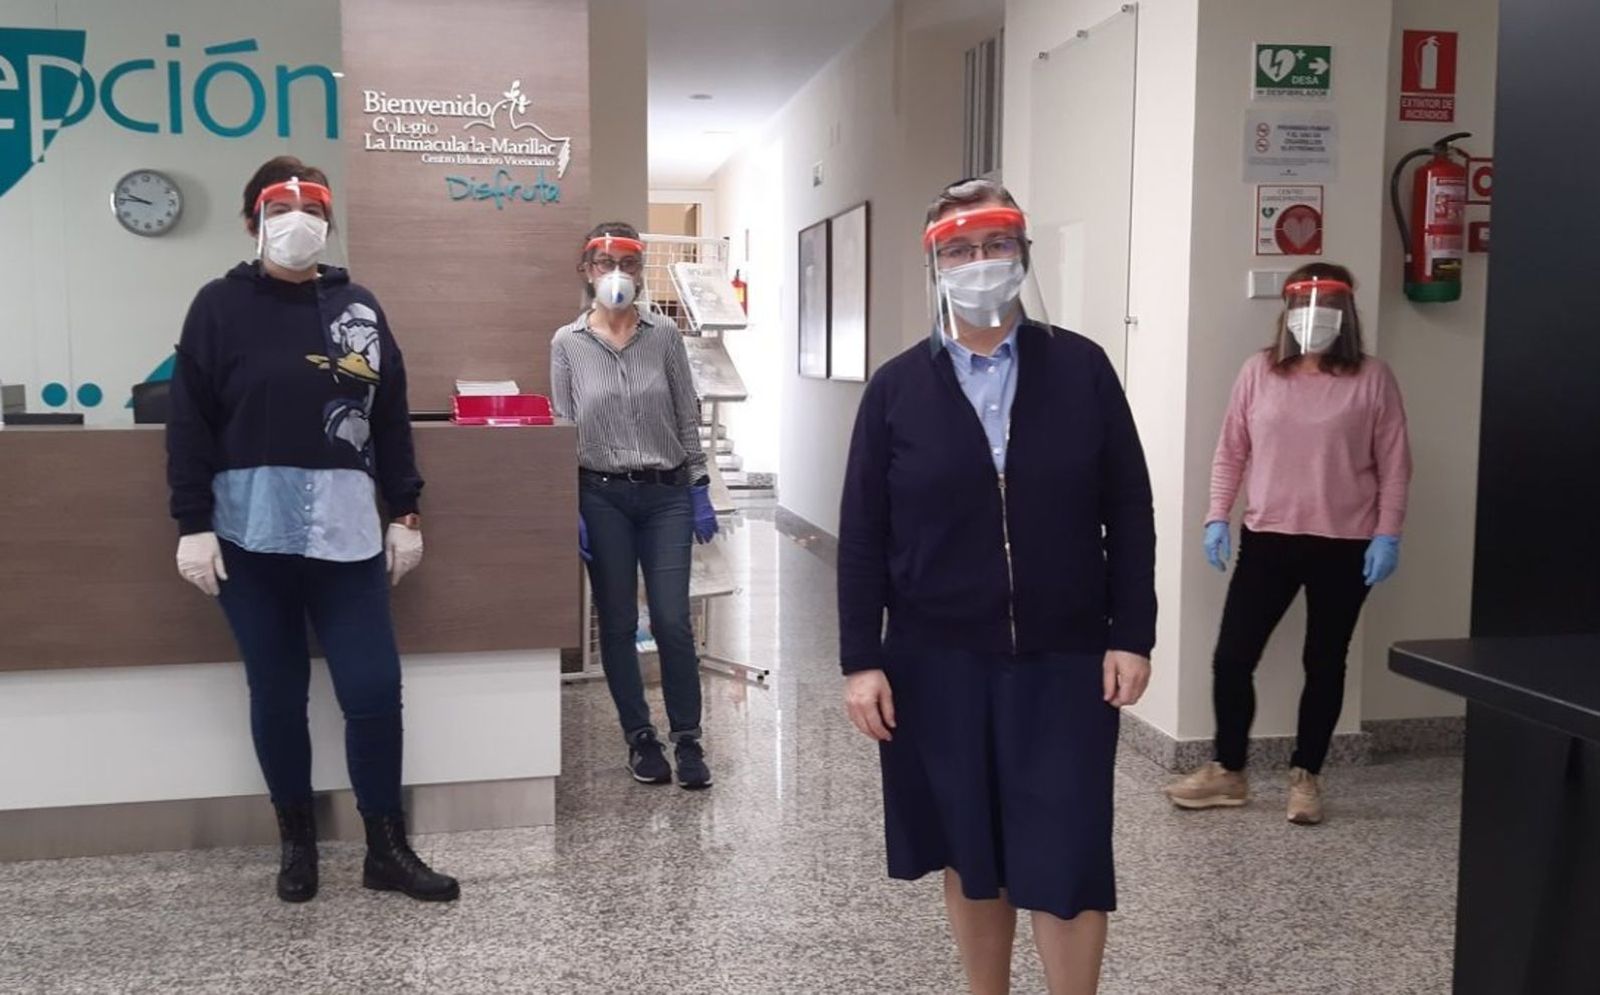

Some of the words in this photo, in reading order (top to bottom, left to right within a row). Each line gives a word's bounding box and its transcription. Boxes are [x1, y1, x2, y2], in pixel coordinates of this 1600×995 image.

[1291, 75, 1319, 85] DESA
[0, 34, 338, 163] pción
[363, 90, 492, 117] Bienvenido
[1442, 99, 1454, 109] DE
[372, 116, 438, 138] Colegio
[364, 133, 386, 151] La
[421, 153, 456, 164] Centro
[457, 154, 502, 166] Educativo
[503, 156, 556, 167] Vicenciano
[445, 169, 561, 210] Disfruta
